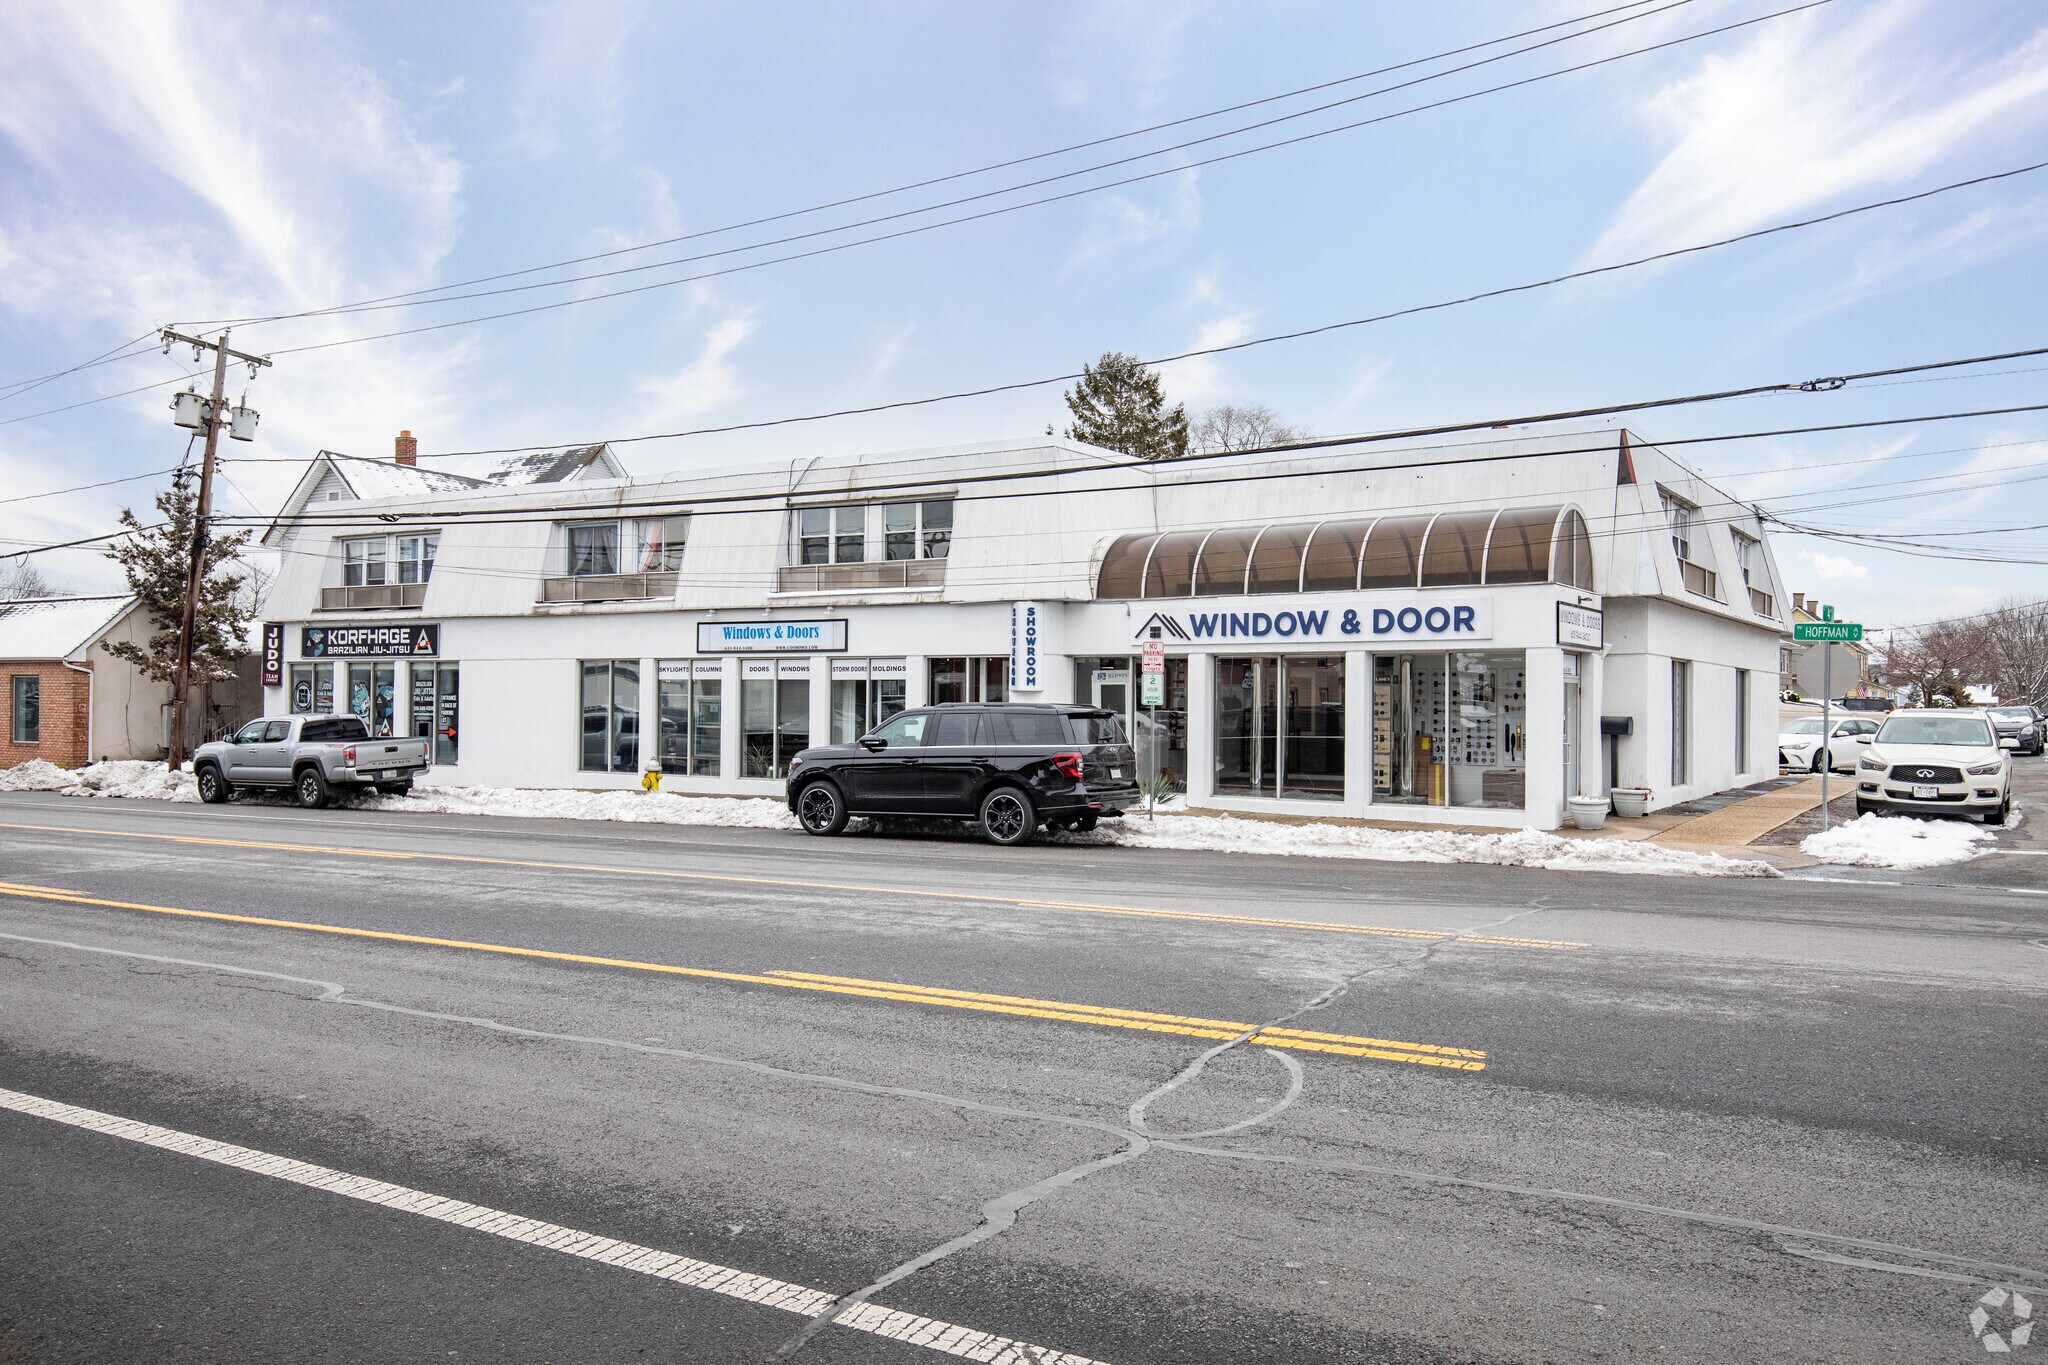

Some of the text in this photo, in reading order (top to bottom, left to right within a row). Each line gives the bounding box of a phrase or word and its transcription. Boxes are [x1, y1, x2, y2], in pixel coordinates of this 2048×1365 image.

[1190, 606, 1475, 637] WINDOW & DOOR
[328, 629, 410, 645] KORFHAGE
[723, 625, 819, 639] Windows & Doors
[1805, 627, 1848, 638] HOFFMAN
[267, 628, 278, 671] JUDO
[370, 645, 410, 653] JIU-JITSU
[1026, 607, 1036, 686] SHOWROOM
